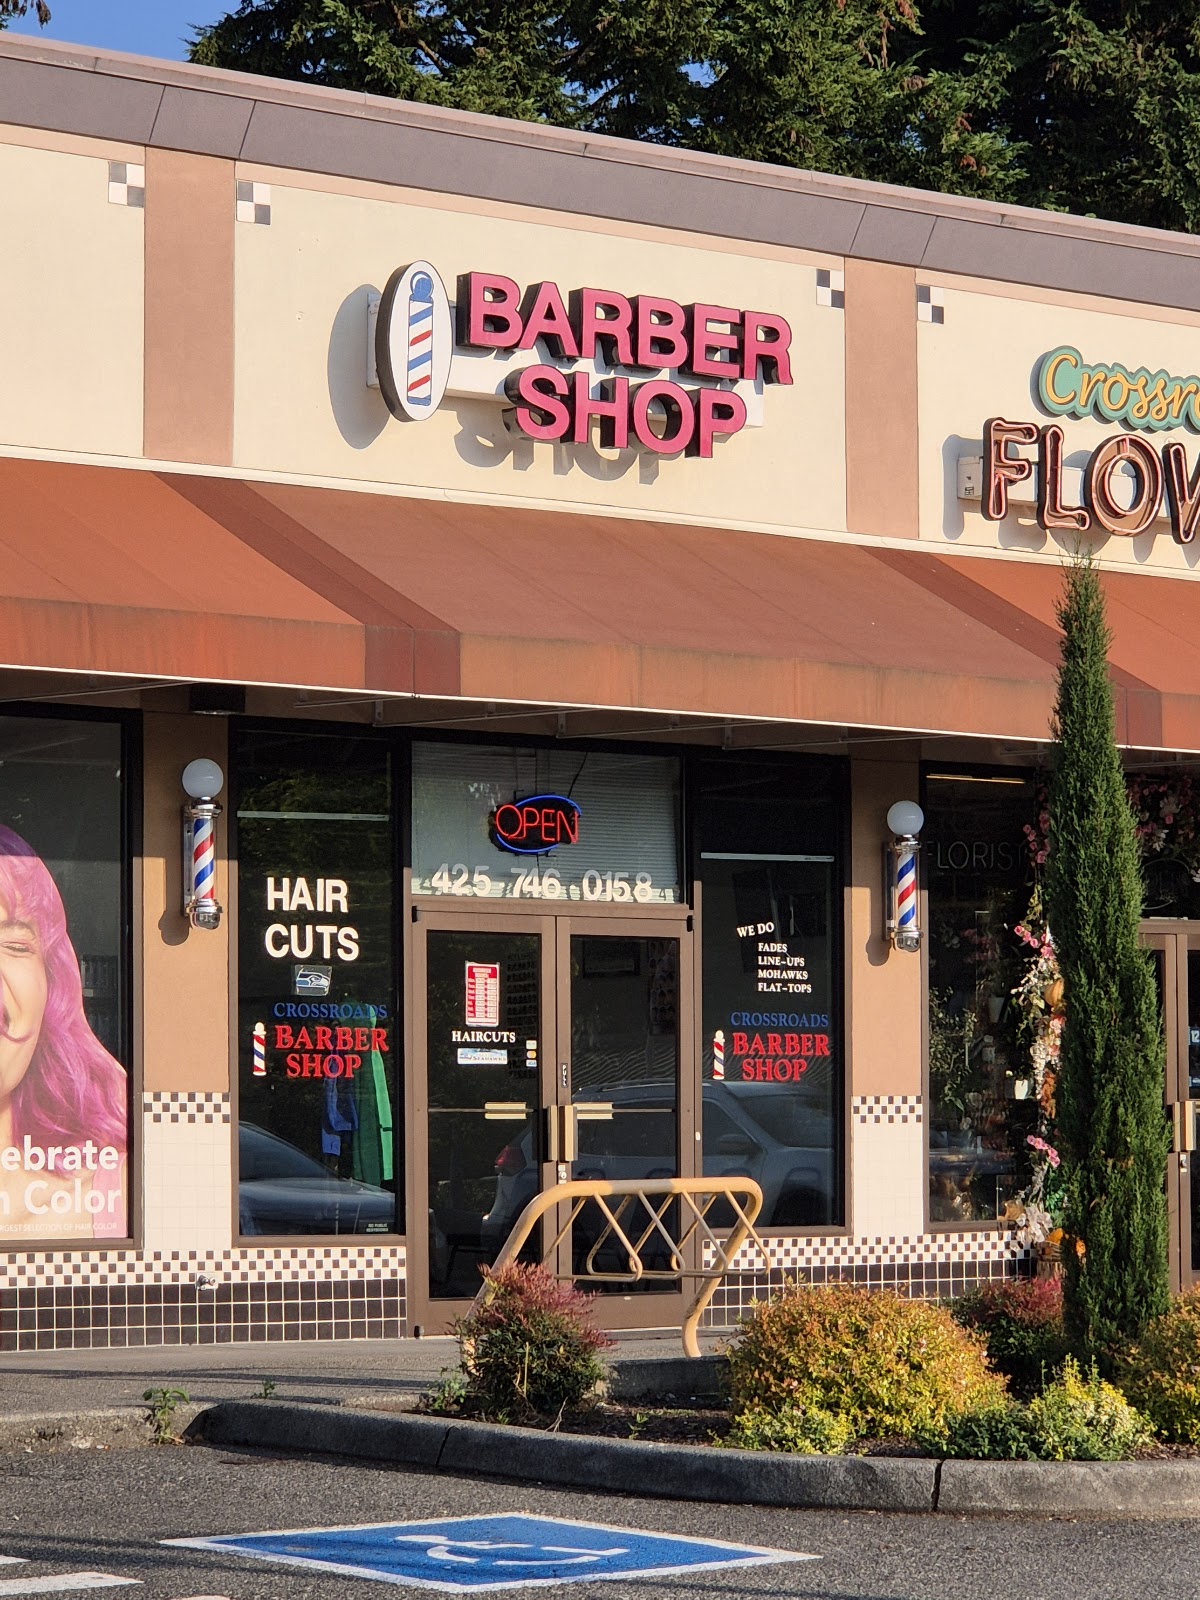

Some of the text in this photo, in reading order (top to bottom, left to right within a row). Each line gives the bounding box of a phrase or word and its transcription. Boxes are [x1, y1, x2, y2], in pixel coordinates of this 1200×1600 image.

[457, 271, 794, 386] BARBER
[1045, 353, 1200, 421] Crossr
[505, 363, 748, 459] SHOP
[496, 805, 579, 844] OPEN
[266, 876, 349, 913] HAIR
[737, 921, 775, 938] WE DO
[264, 923, 360, 961] CUTS
[758, 943, 788, 953] FADES
[758, 956, 805, 967] LINE-UPS
[758, 969, 808, 980] MOHAWKS
[758, 982, 812, 994] FLAT-TOPS
[273, 1003, 388, 1019] CROSSROADS
[730, 1012, 829, 1027] CROSSROADS
[274, 1025, 390, 1051] BARBER
[451, 1030, 516, 1043] HAIRCUTS
[732, 1032, 830, 1056] BARBER
[286, 1054, 362, 1078] SHOP
[742, 1059, 807, 1082] SHOP
[24, 1178, 121, 1215] Color
[23, 1224, 62, 1232] SELECTION
[75, 1223, 92, 1231] HAIR
[93, 1222, 117, 1230] COLOR
